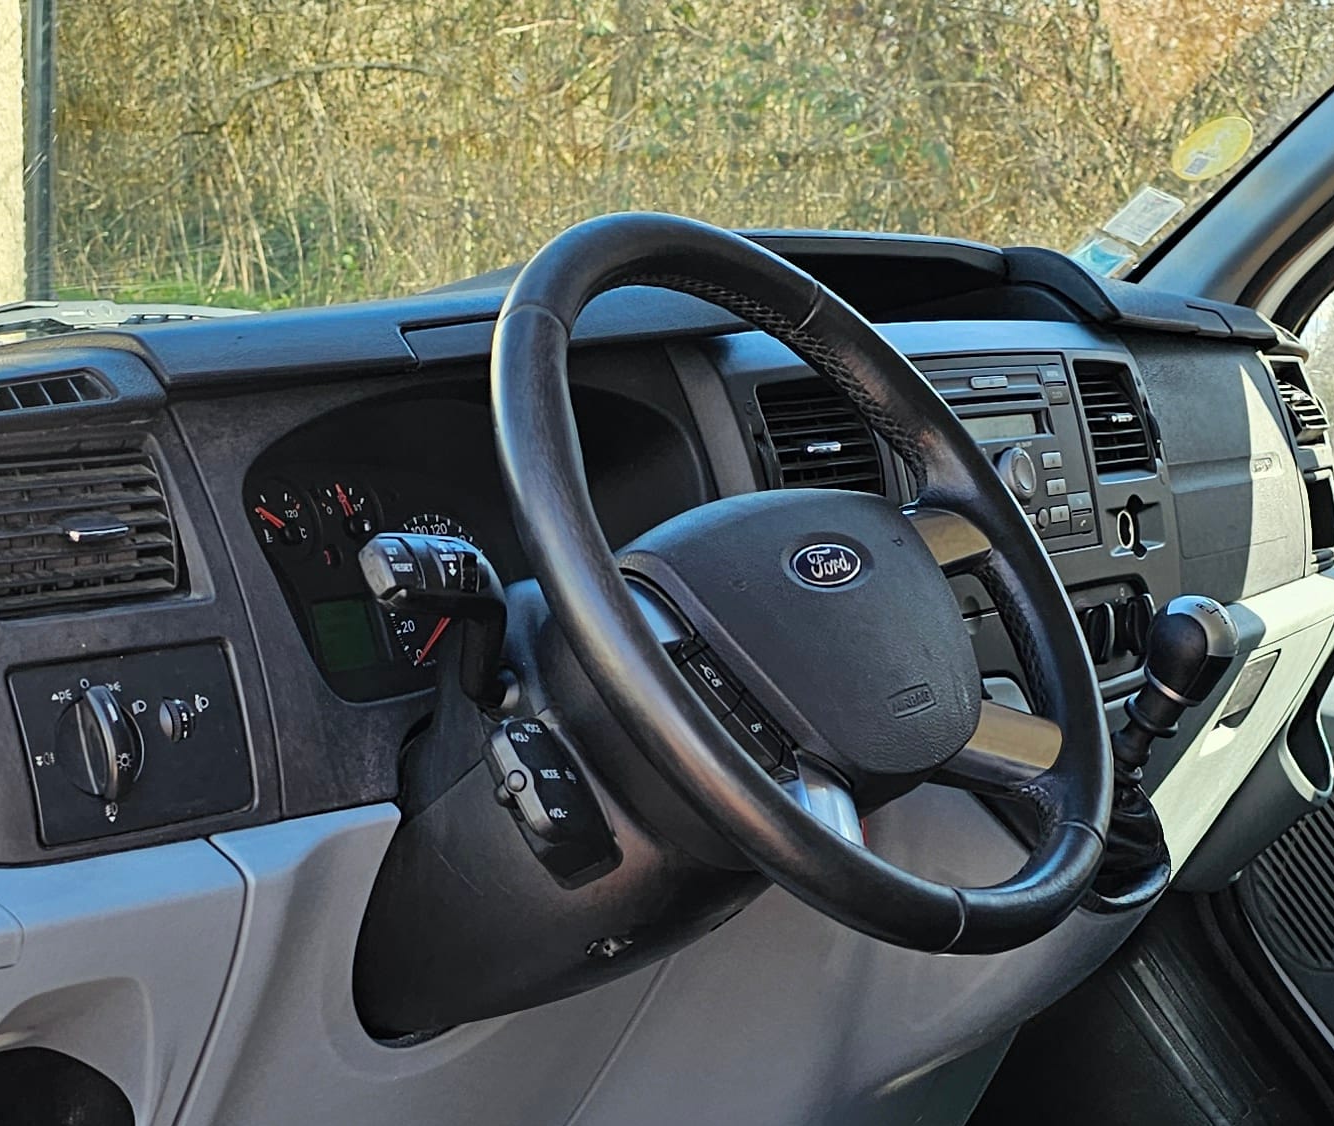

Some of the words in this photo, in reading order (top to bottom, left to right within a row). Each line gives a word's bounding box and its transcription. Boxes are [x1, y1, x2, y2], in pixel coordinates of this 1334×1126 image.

[284, 509, 299, 519] 120
[430, 522, 448, 535] 120
[807, 548, 851, 578] Ford
[401, 619, 416, 633] 20
[180, 712, 189, 722] 2
